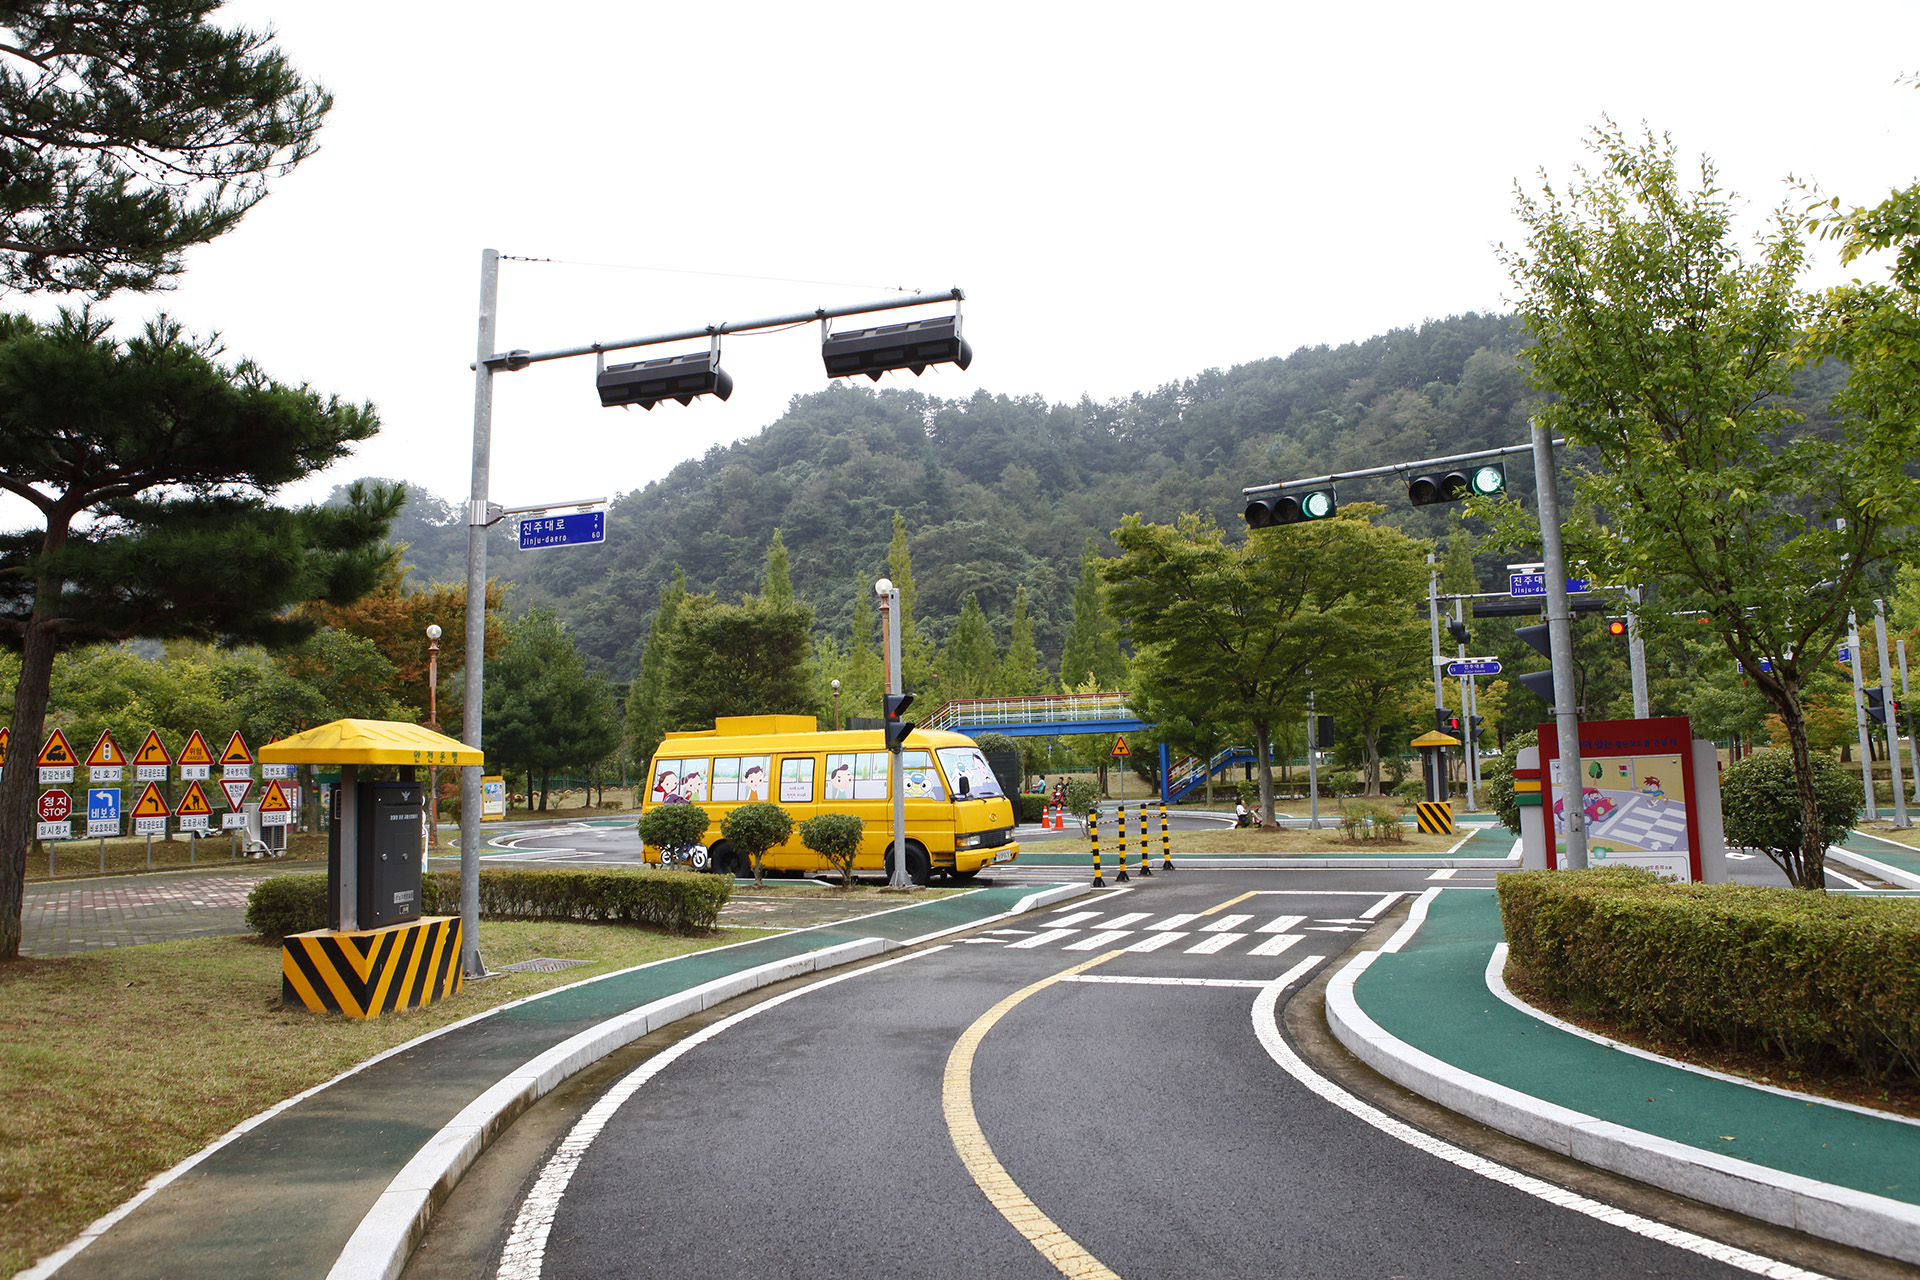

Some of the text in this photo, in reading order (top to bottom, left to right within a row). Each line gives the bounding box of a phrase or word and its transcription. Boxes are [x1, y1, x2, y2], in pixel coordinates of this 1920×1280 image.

[523, 519, 565, 535] 진주대로
[523, 534, 567, 546] Jinju-daero
[592, 531, 600, 539] 60
[1513, 576, 1543, 586] 진주대
[190, 748, 202, 756] 위험
[414, 751, 458, 764] 안전운행
[93, 770, 119, 779] 신호기
[44, 797, 67, 807] 정지
[43, 808, 67, 816] STOP
[91, 807, 117, 818] 비보호
[40, 826, 68, 835] 일시정지
